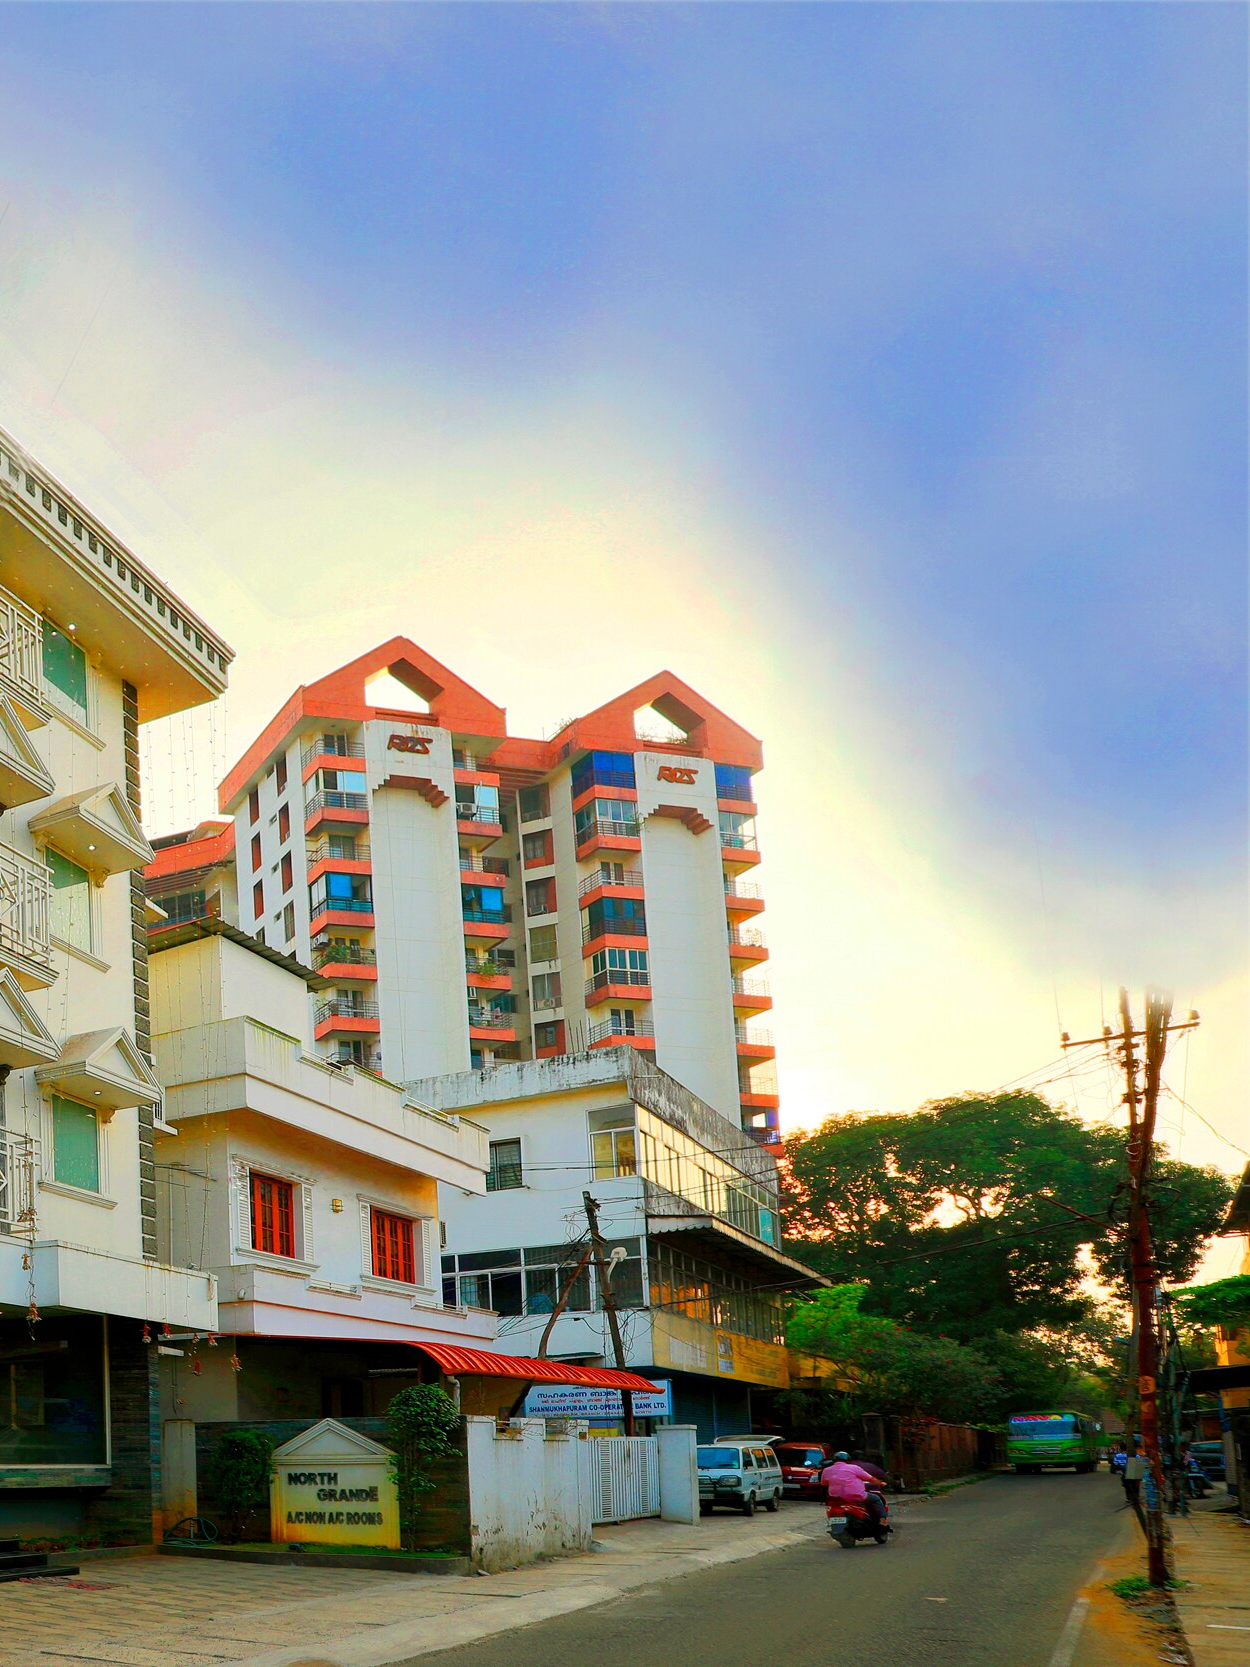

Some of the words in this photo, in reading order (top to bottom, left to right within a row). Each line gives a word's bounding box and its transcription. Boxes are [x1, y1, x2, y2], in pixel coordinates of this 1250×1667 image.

[529, 1404, 588, 1413] SHANMUKHAPURAM
[287, 1472, 338, 1486] NORTH
[286, 1511, 305, 1525] A/C
[304, 1511, 327, 1525] NON
[327, 1511, 345, 1525] A/C
[345, 1512, 384, 1526] ROOMS
